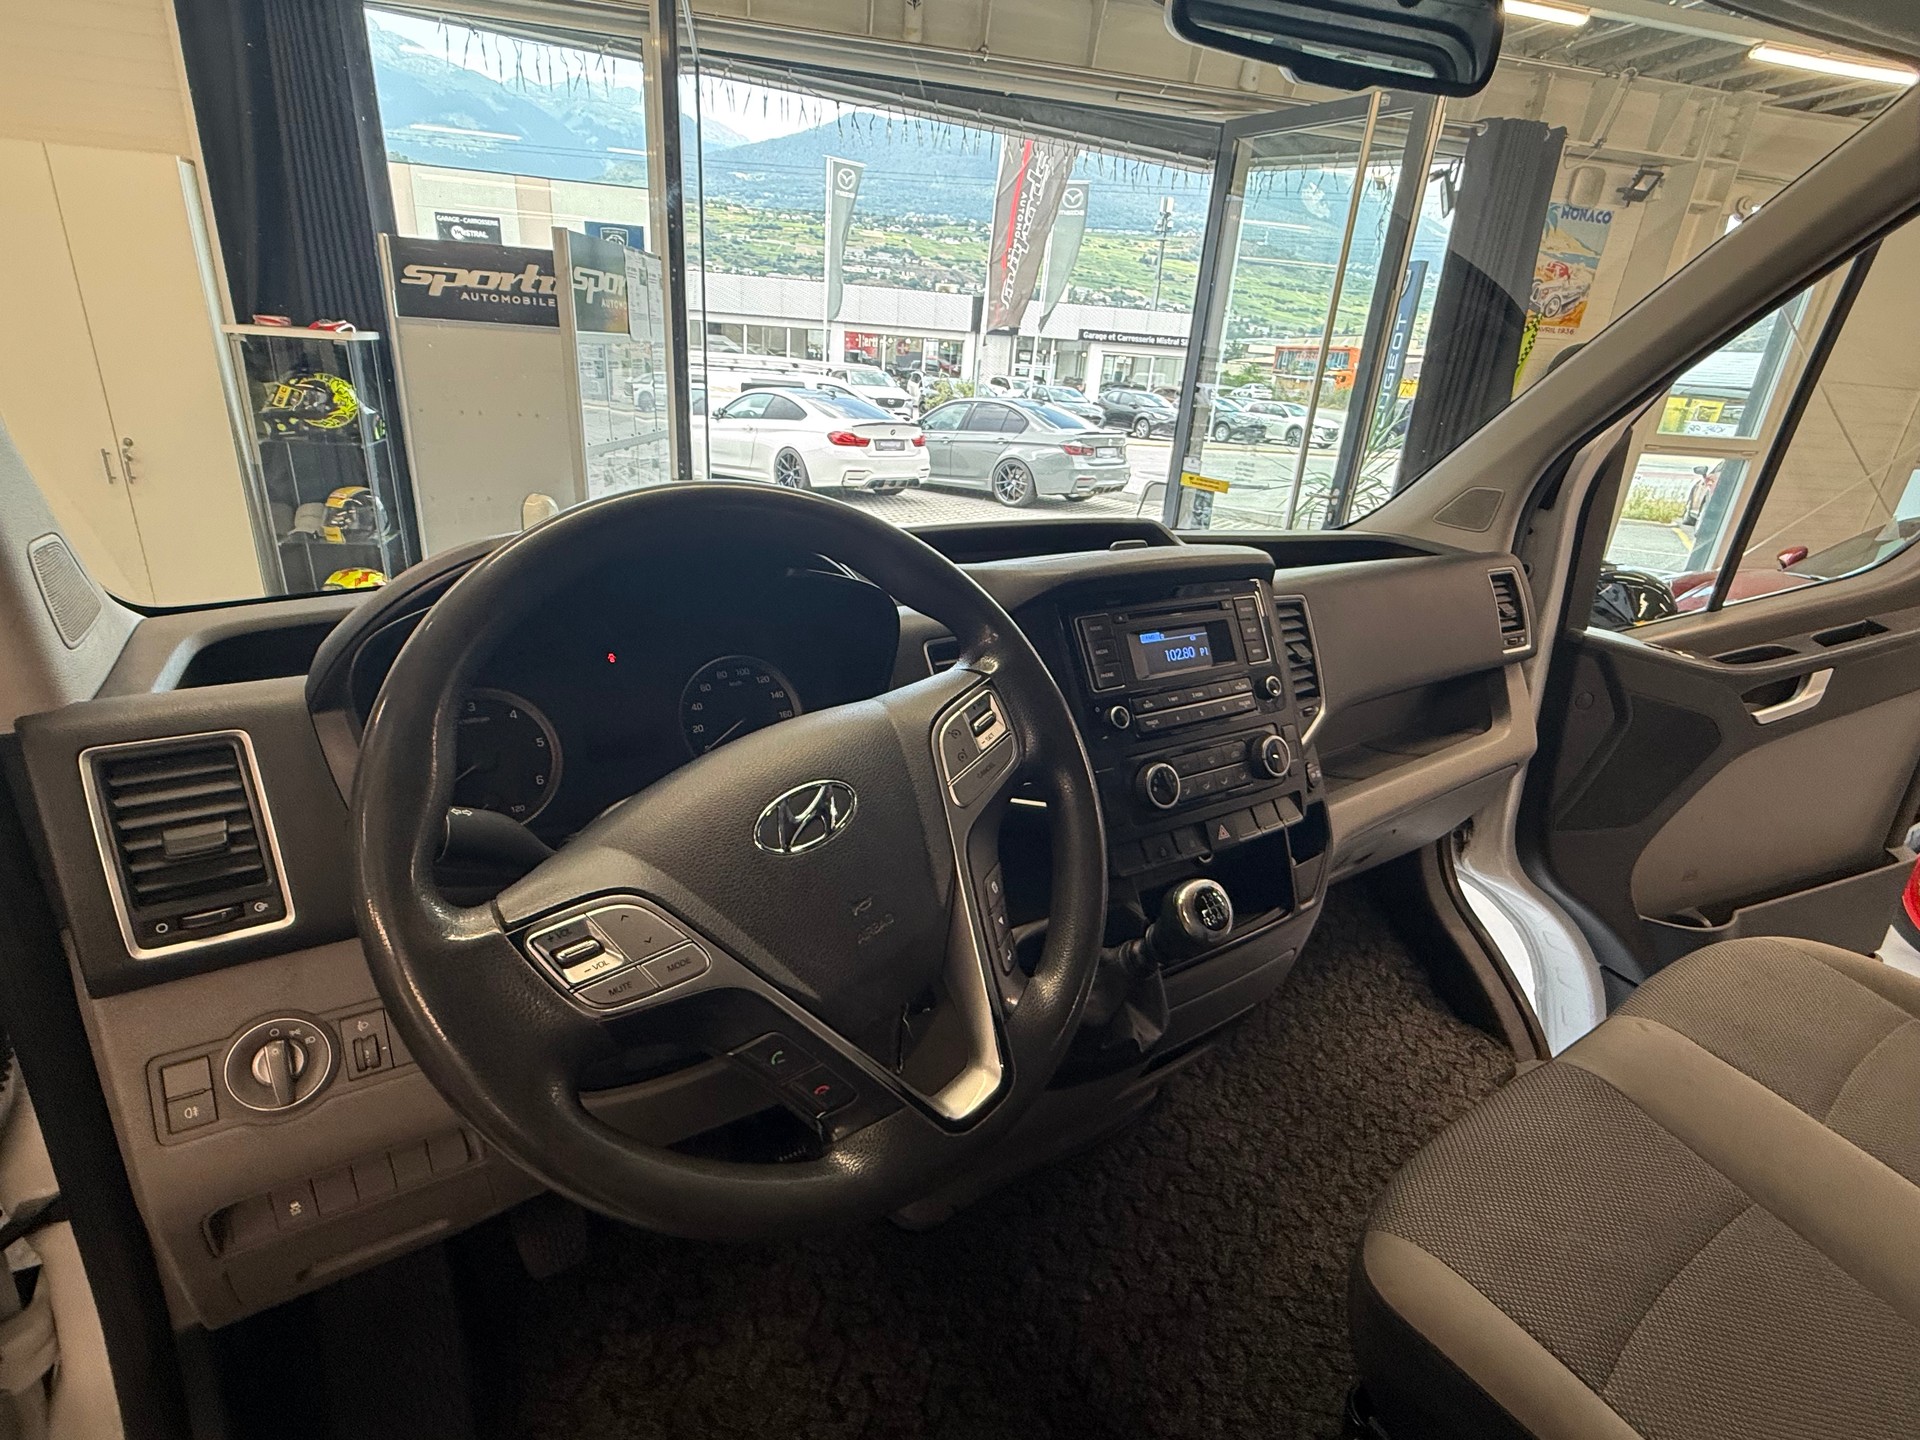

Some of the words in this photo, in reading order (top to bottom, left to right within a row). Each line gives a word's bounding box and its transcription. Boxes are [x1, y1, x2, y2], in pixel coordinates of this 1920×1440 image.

[1560, 206, 1613, 225] MONACO
[1083, 331, 1107, 342] Garage
[1108, 333, 1116, 341] et
[1117, 334, 1155, 344] Carrosserie
[1156, 336, 1180, 346] Mistral
[716, 670, 728, 679] 80
[756, 675, 770, 684] 120
[770, 690, 784, 699] 140
[467, 702, 476, 712] 3
[691, 702, 703, 711] 40
[509, 709, 518, 719] 4
[779, 710, 793, 719] 160
[692, 724, 704, 734] 20
[536, 737, 545, 748] 5
[535, 774, 545, 785] 6
[592, 959, 611, 971] VOL
[666, 957, 693, 973] MODE
[607, 981, 633, 997] MUTE
